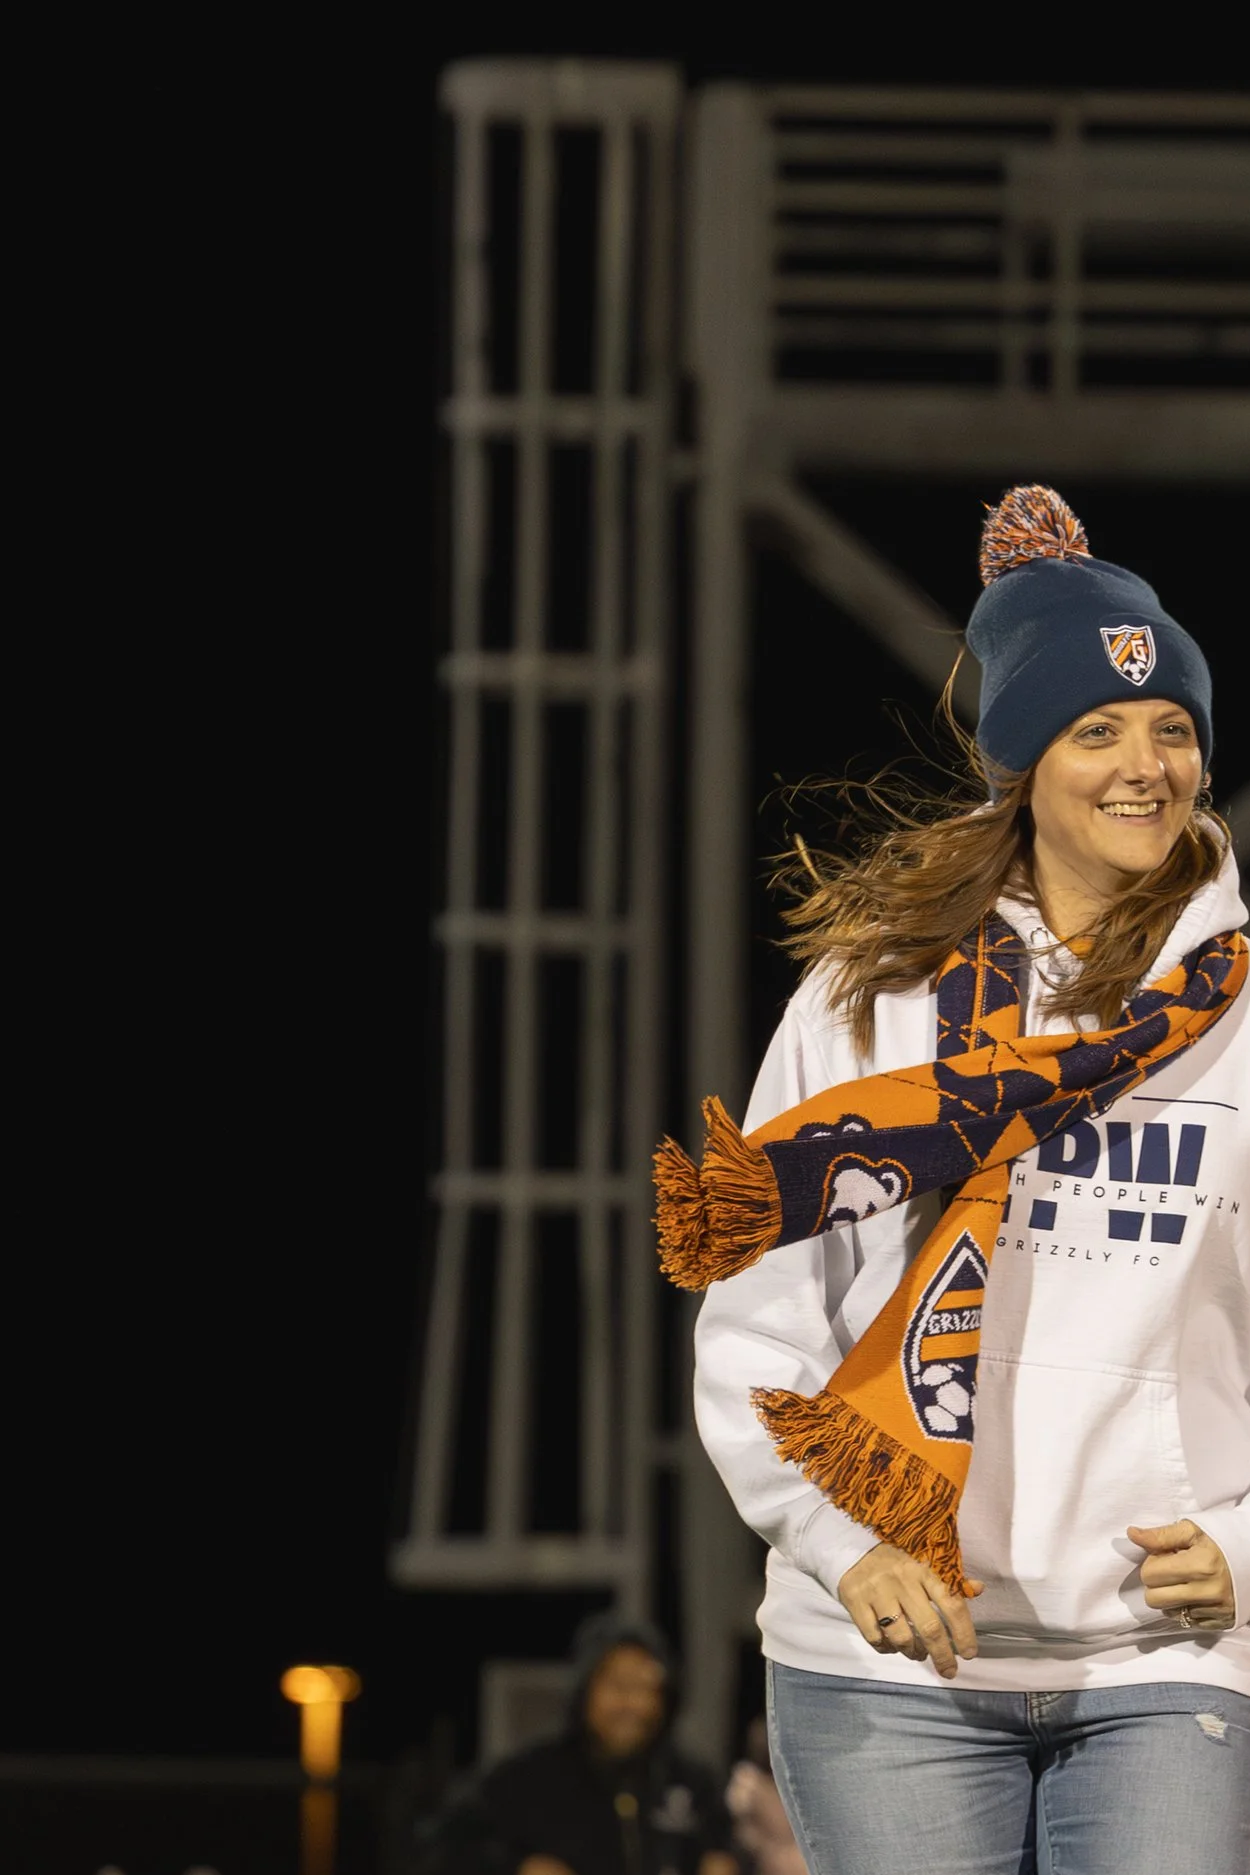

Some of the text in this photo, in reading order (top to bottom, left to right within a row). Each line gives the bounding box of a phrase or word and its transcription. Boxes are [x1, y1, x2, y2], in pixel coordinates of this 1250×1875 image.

[1053, 1179, 1240, 1214] PEOPLE WIN
[995, 1236, 1160, 1267] GRIZZLY FC
